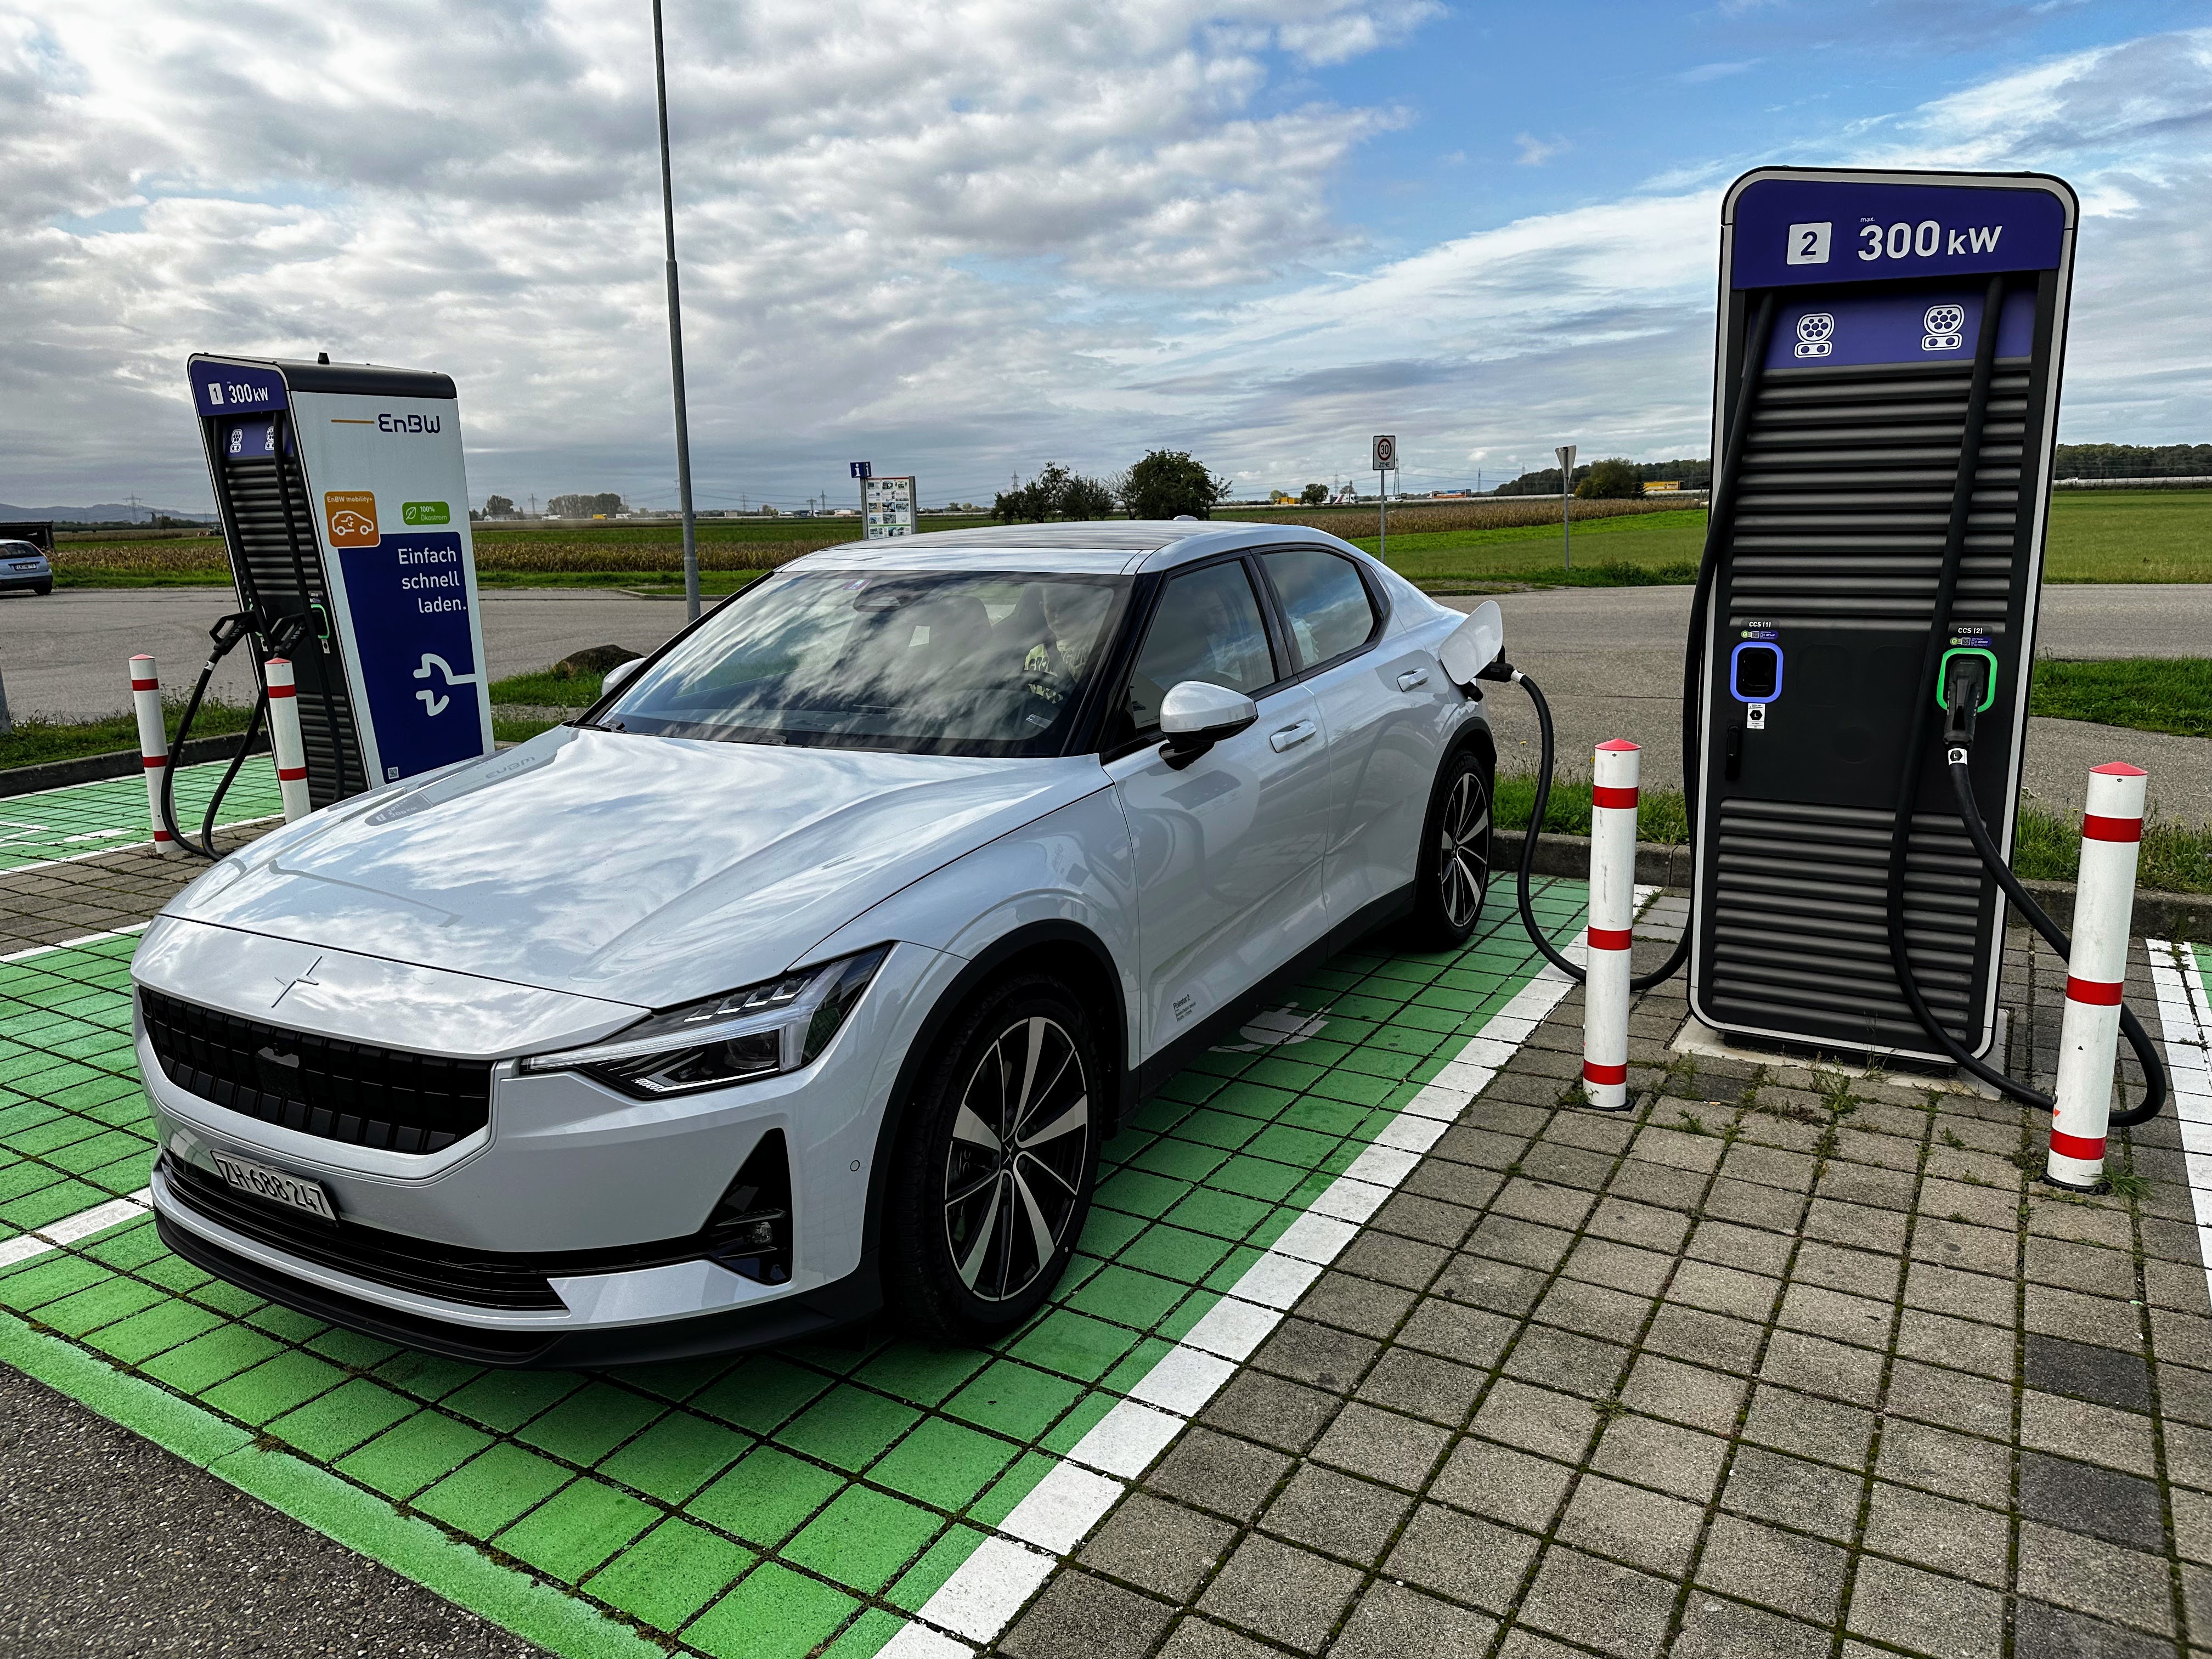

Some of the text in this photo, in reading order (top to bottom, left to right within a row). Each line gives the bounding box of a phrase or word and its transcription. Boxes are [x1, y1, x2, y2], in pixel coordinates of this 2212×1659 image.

[1801, 221, 2002, 261] 2 300 kW
[213, 383, 268, 403] 1 300 kW
[378, 414, 441, 433] EnBW
[1380, 444, 1389, 454] 30
[398, 547, 456, 565] Einfach
[402, 571, 460, 590] schnell
[418, 597, 466, 613] laden.
